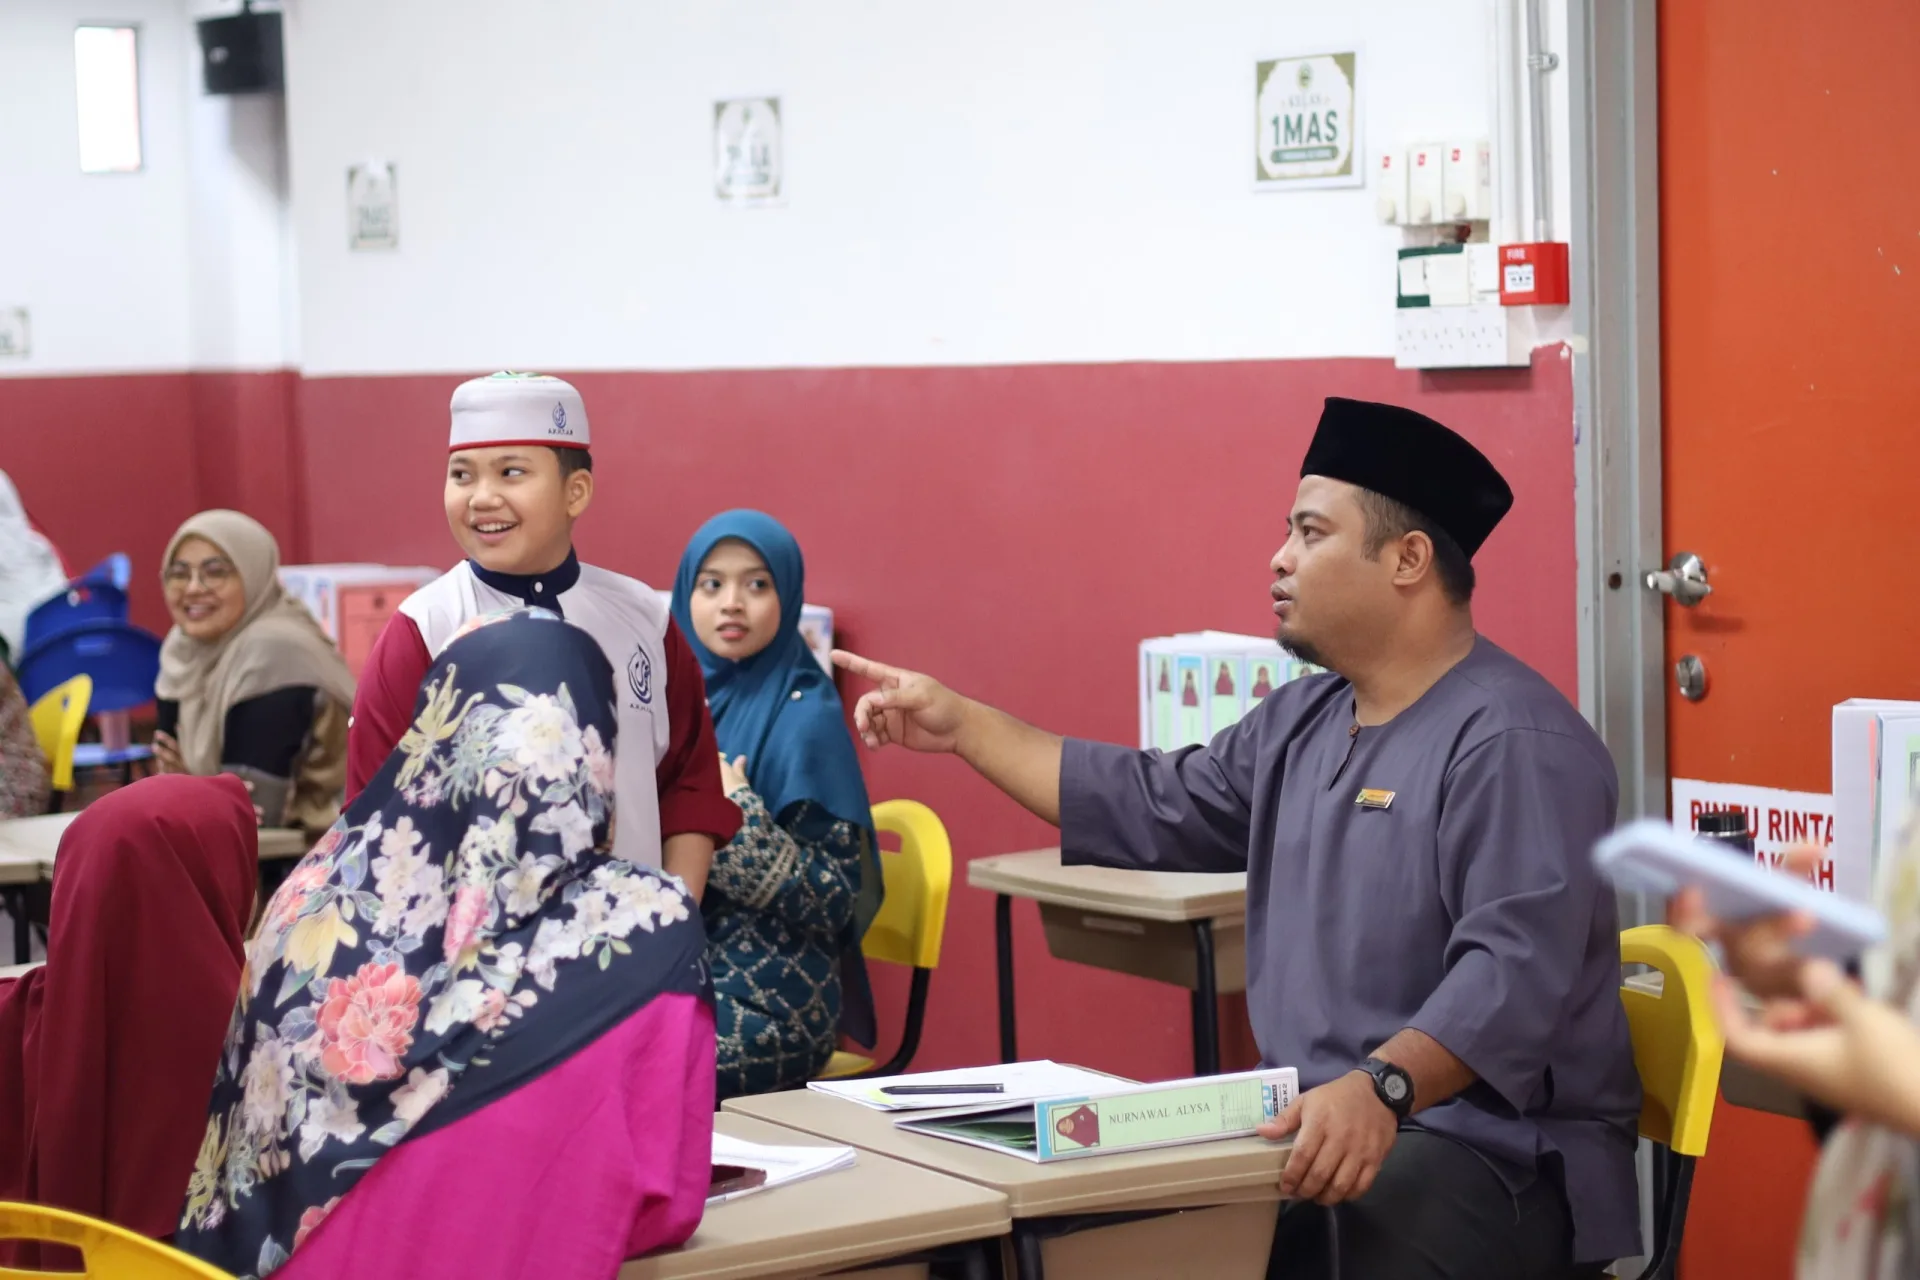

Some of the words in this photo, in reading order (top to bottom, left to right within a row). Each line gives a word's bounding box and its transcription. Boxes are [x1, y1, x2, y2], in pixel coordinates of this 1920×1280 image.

[1271, 109, 1338, 146] 1MAS
[1109, 1107, 1170, 1125] NURNAWAL
[1176, 1102, 1210, 1116] ALYSA
